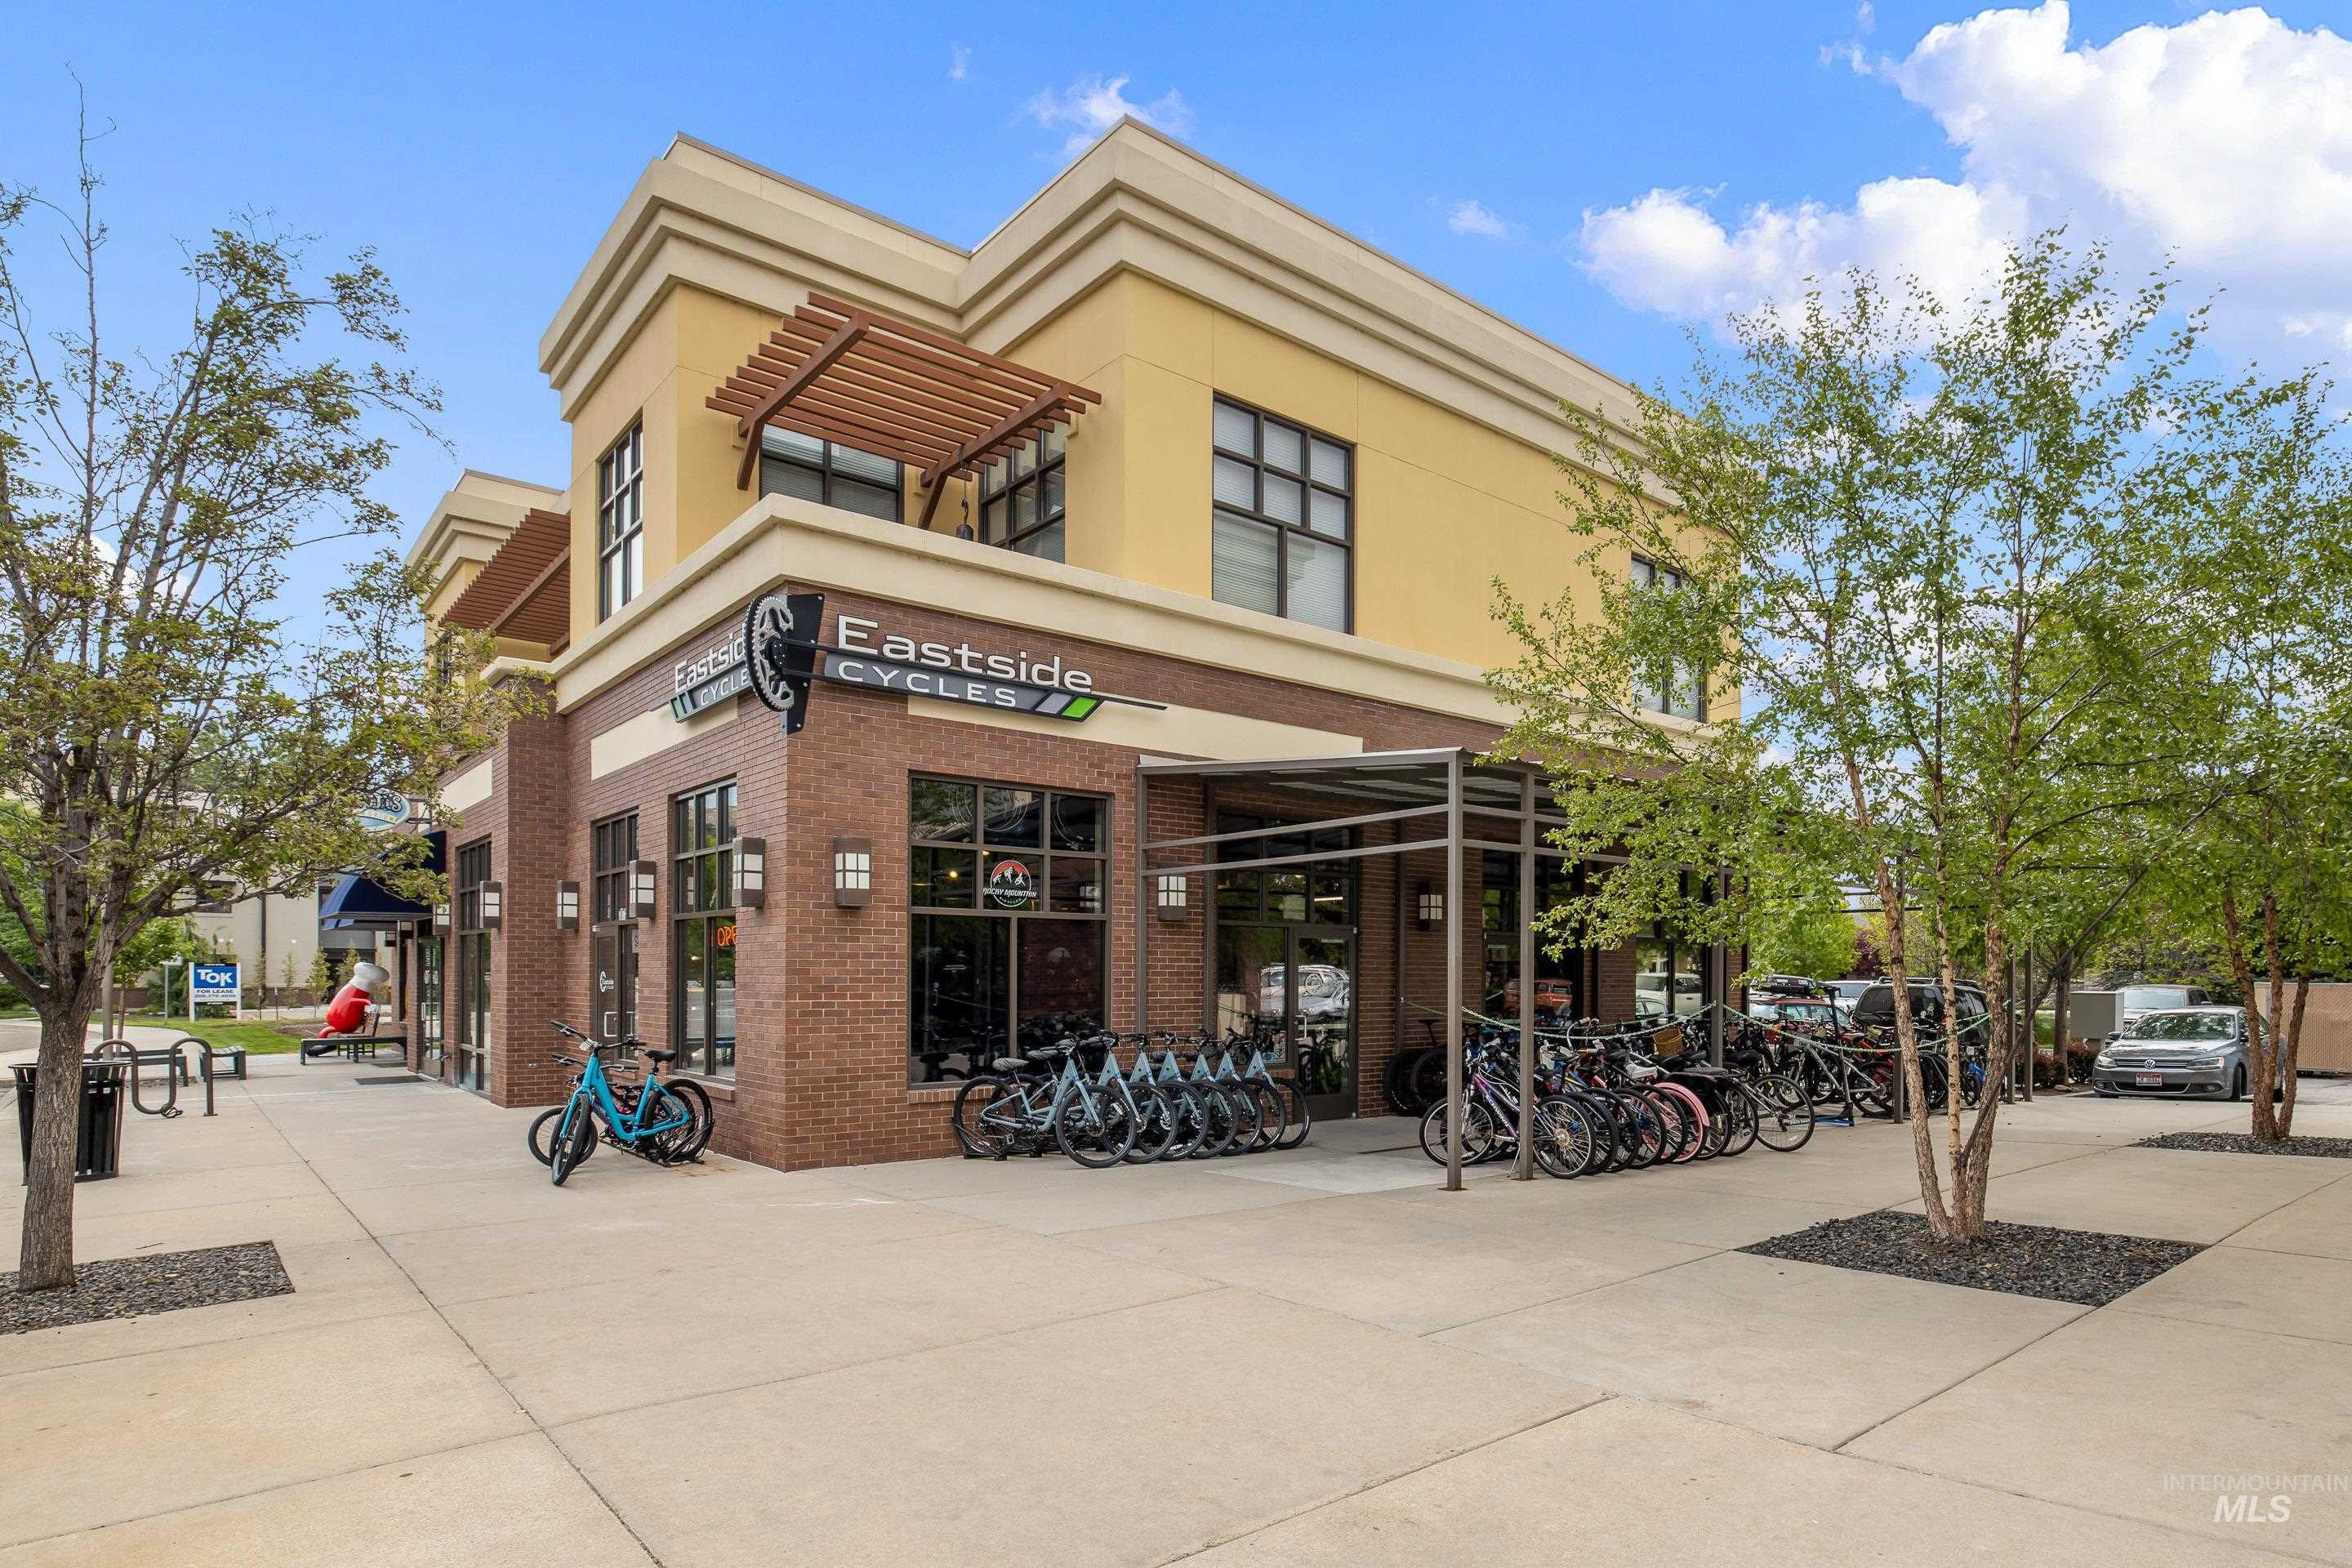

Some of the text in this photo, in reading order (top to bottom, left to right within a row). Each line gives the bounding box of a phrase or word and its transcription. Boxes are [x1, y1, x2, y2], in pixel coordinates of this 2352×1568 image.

[675, 621, 746, 694] Eastsid
[837, 613, 1093, 693] Eastside
[700, 667, 751, 706] CYCLE
[837, 661, 1017, 707] CYCLES
[717, 925, 737, 947] OPE
[197, 969, 234, 987] TOK
